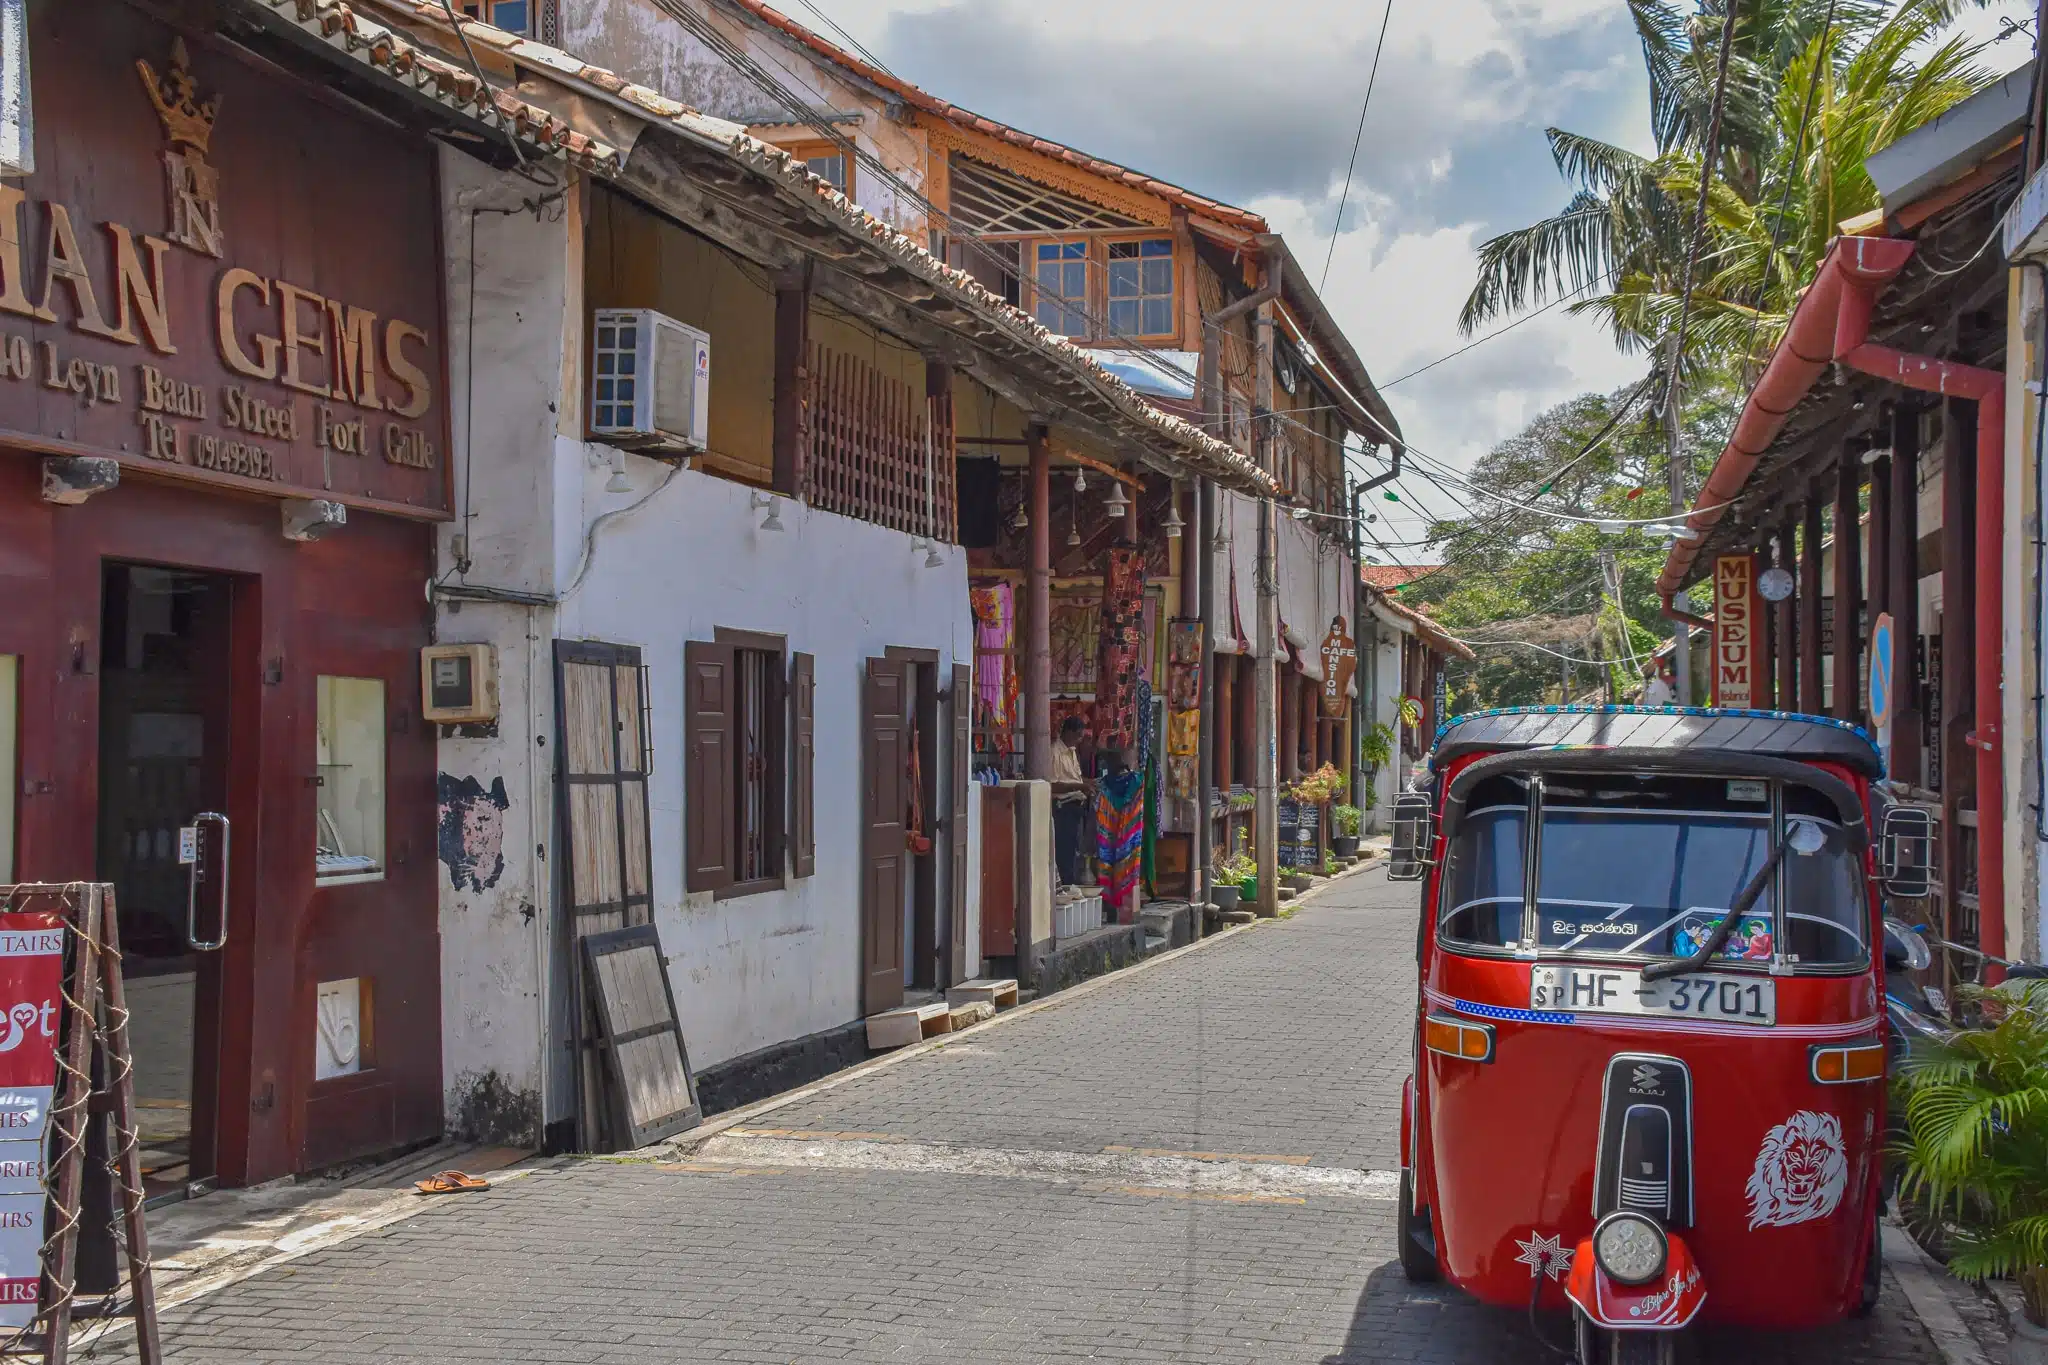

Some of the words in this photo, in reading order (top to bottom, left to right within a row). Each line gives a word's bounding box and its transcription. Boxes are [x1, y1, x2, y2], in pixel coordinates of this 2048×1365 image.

[219, 268, 430, 418] GEMS
[46, 341, 121, 408] Leyn
[142, 364, 207, 419] Baan
[224, 384, 299, 441] Street
[317, 404, 369, 455] Fort
[384, 422, 434, 468] Galle
[141, 410, 184, 463] Tel
[1720, 561, 1748, 684] MUSEUM
[1321, 647, 1355, 657] CAFE
[1326, 638, 1341, 696] MANSION
[1571, 972, 1621, 1007] HF
[1669, 979, 1767, 1018] 3701
[1629, 1087, 1666, 1097] BAJAJ
[0, 1161, 45, 1178] RIES
